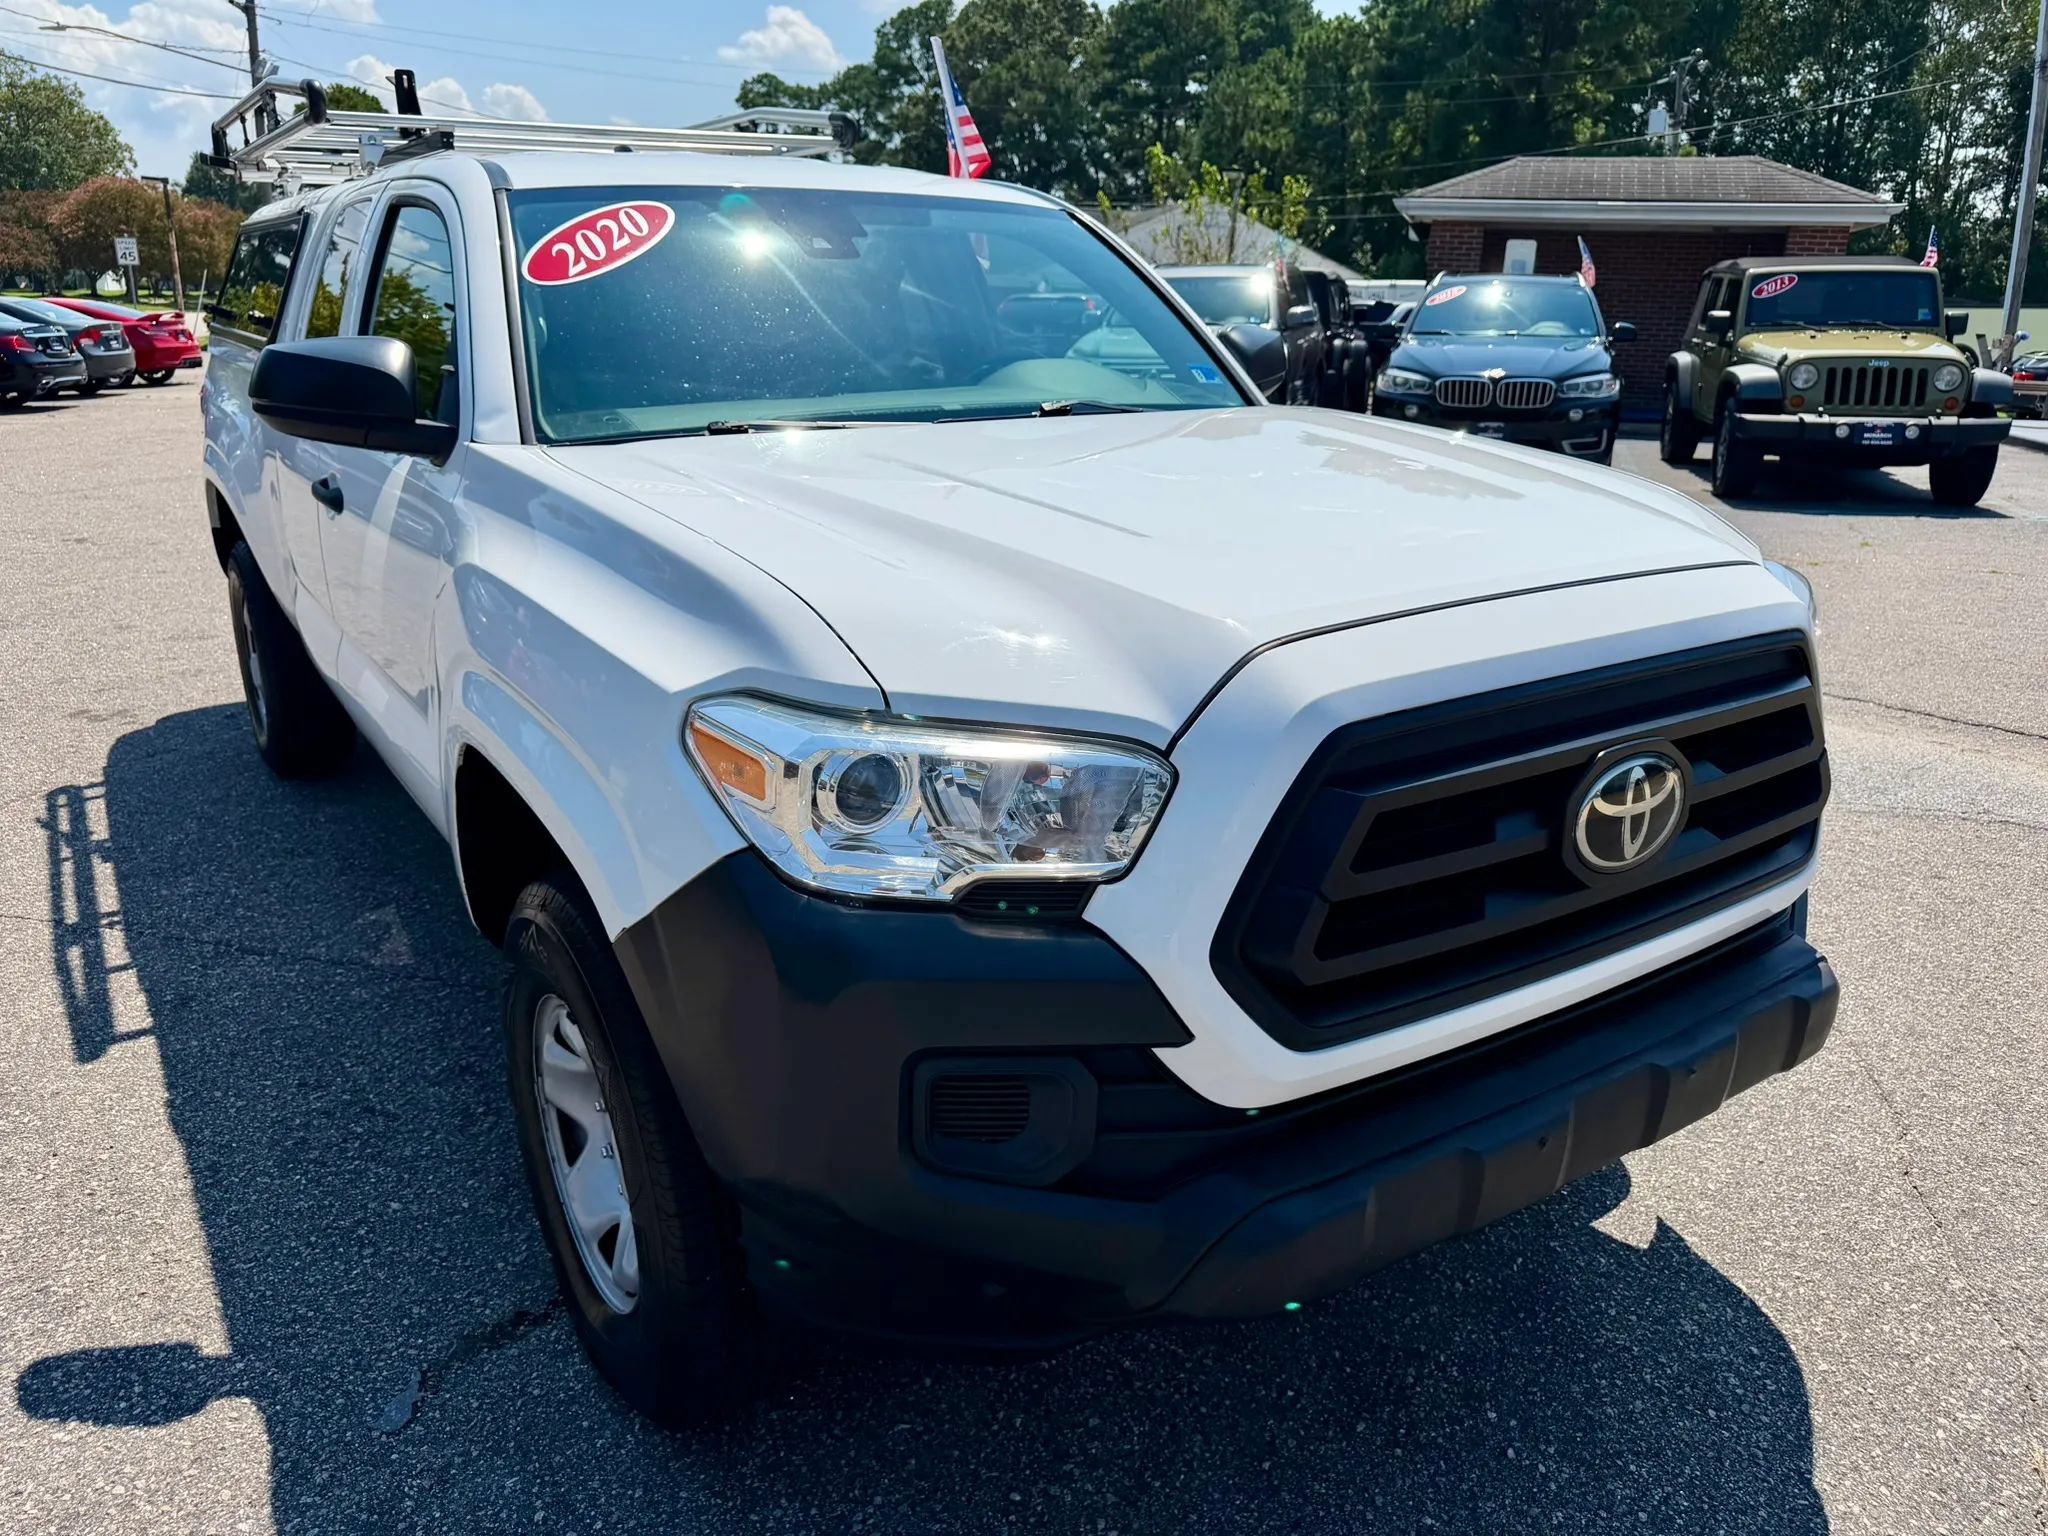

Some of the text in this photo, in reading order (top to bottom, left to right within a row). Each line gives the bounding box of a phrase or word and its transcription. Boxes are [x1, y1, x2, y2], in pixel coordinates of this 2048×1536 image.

[551, 207, 649, 277] 2020
[120, 251, 137, 262] 45
[1761, 276, 1790, 297] 2013
[1868, 358, 1890, 368] Jeep
